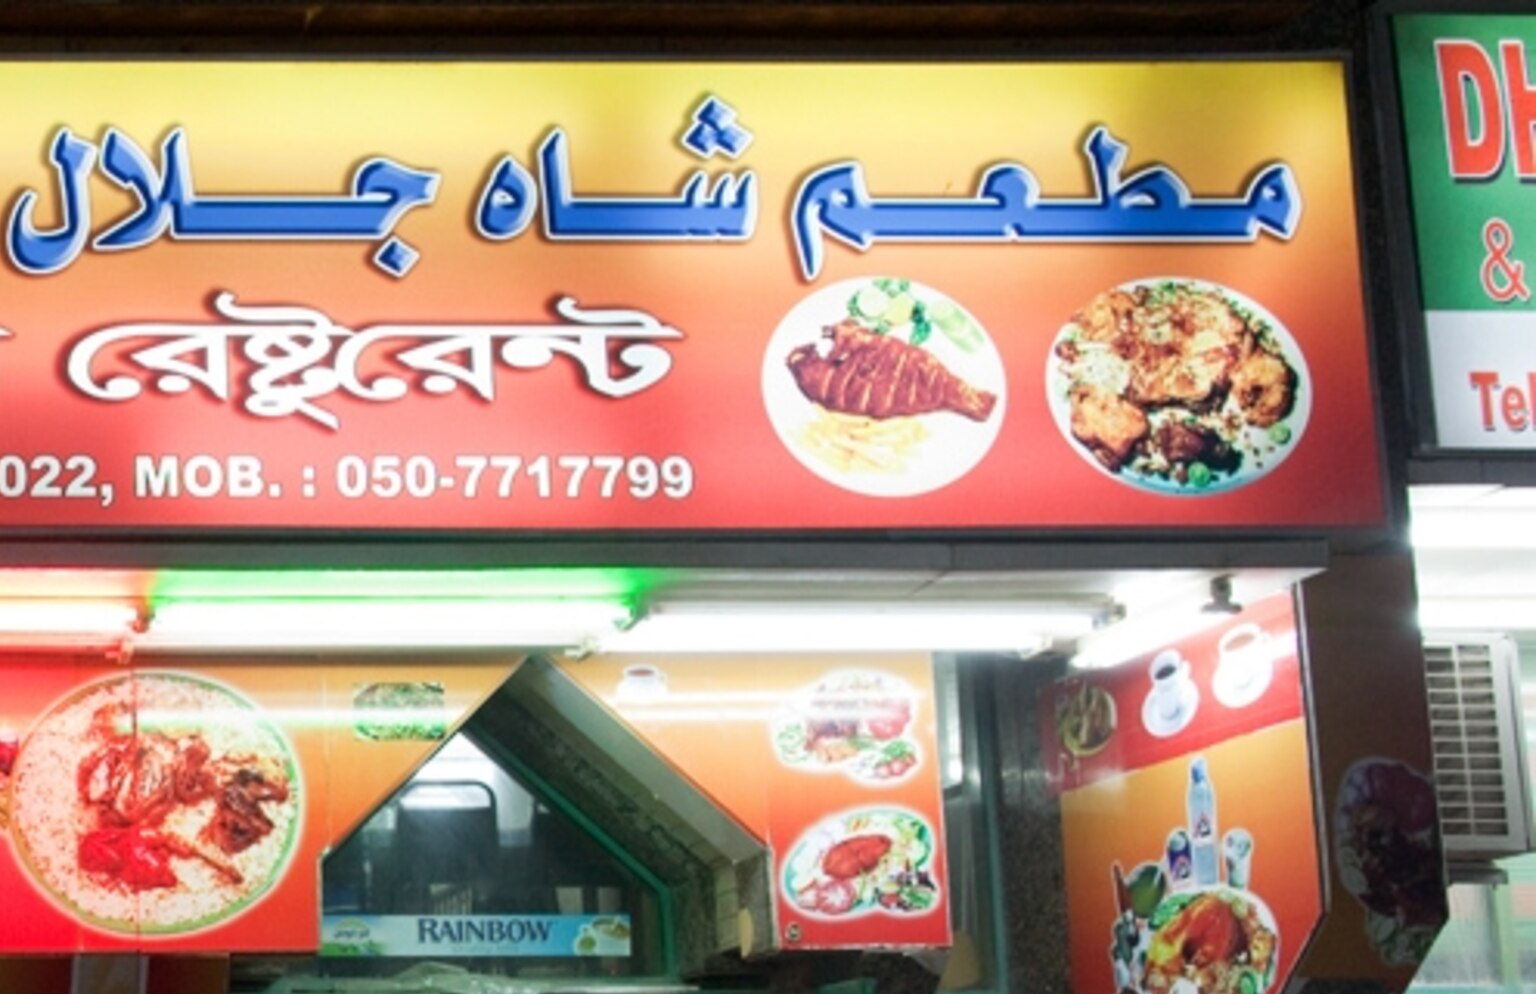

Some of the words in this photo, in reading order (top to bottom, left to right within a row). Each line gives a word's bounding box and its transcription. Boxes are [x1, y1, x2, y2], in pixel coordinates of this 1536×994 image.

[6, 126, 441, 276] جلال
[476, 93, 758, 243] شاه
[793, 125, 1302, 280] مطعم
[1481, 217, 1530, 303] &
[134, 455, 284, 498] MOB.
[336, 455, 695, 498] 050-7717799
[415, 917, 552, 945] RAINBOW
